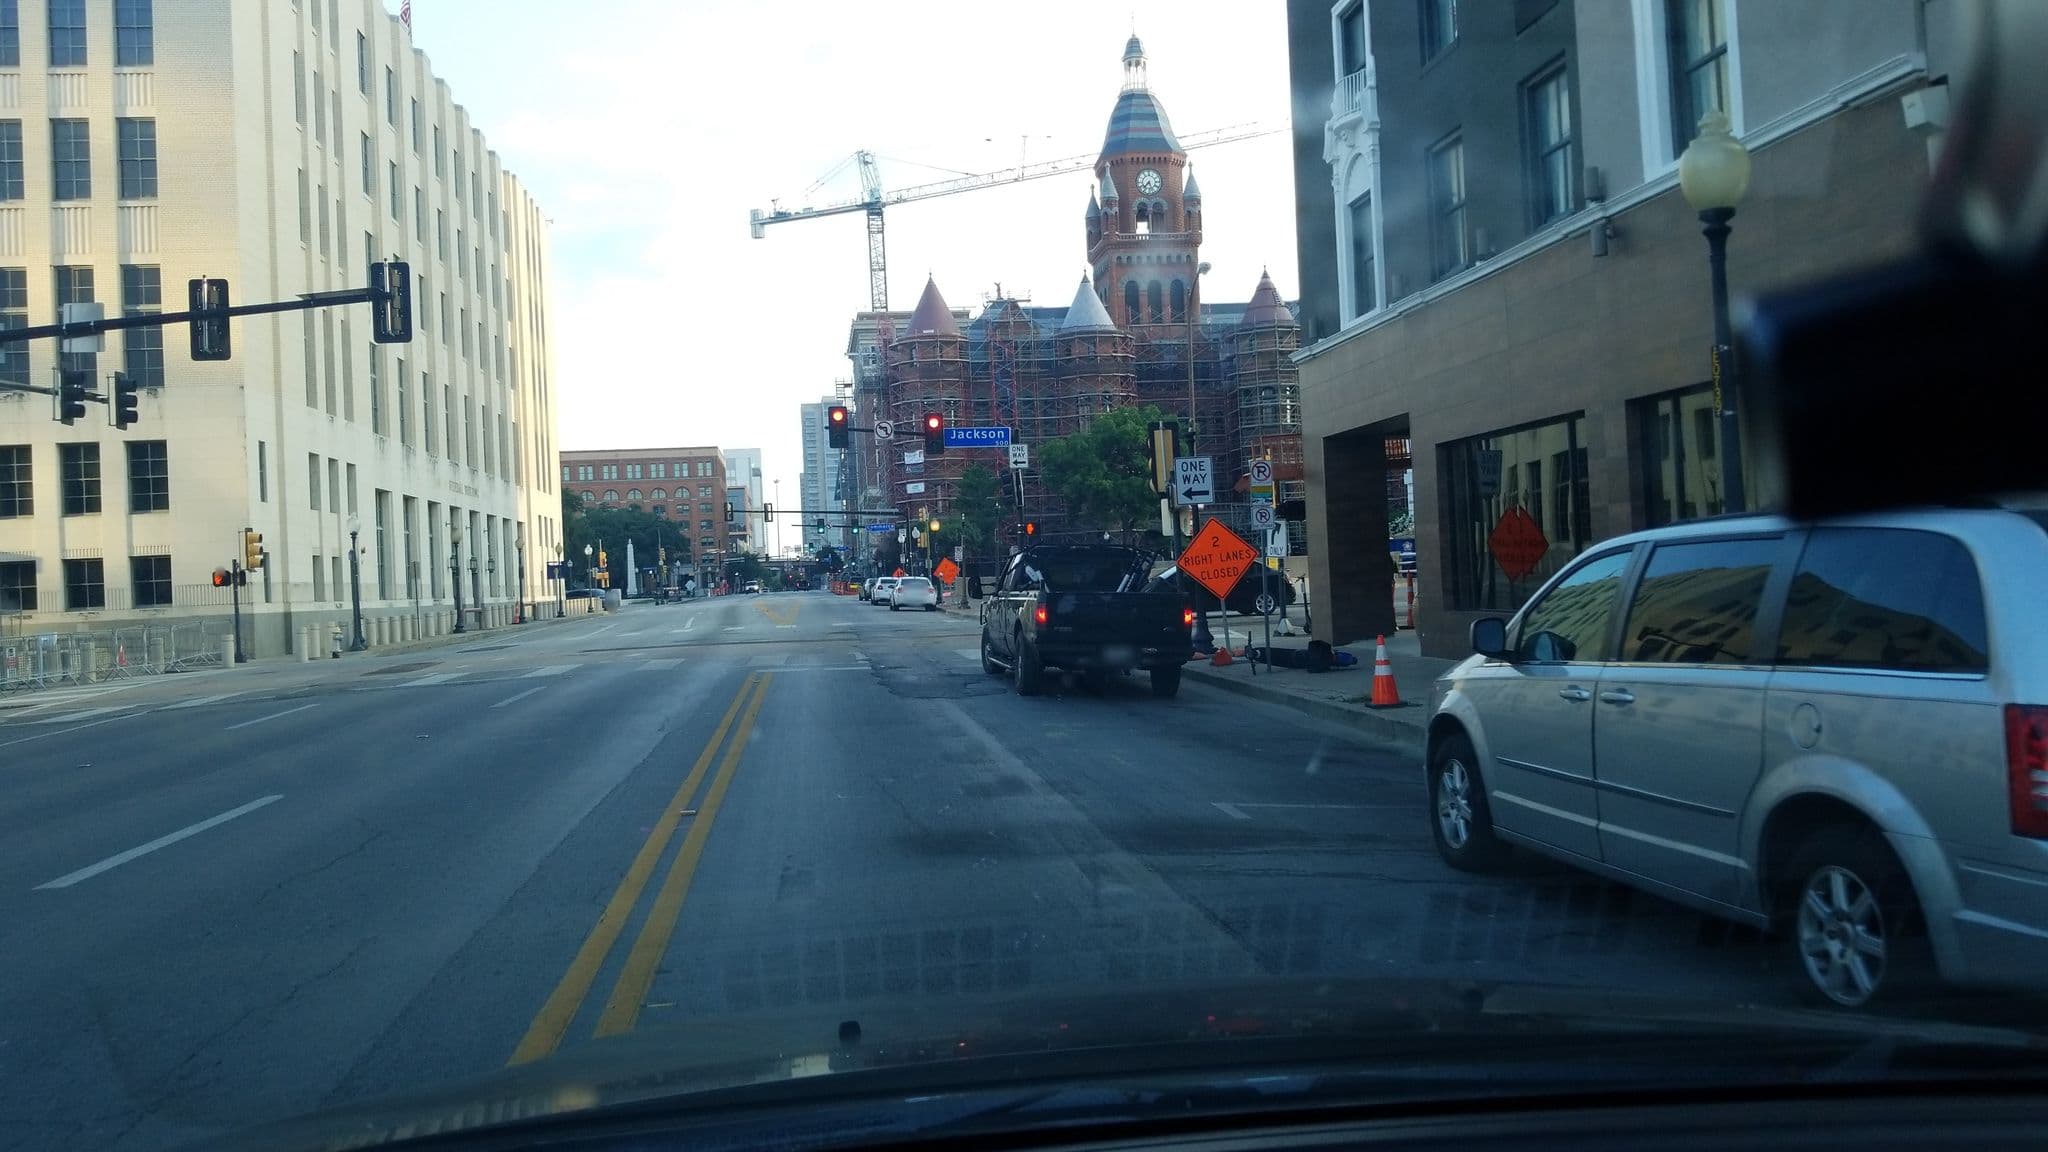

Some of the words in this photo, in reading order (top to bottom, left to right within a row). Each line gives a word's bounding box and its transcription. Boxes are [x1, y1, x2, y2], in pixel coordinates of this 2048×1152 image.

[950, 429, 1005, 440] Jackson
[1181, 460, 1206, 472] ONE
[1182, 473, 1208, 485] WAY
[1211, 536, 1220, 548] 2
[1269, 546, 1284, 555] ONLY
[1184, 553, 1213, 567] RIGHT
[1219, 549, 1252, 562] LANES
[1200, 566, 1240, 580] CLOSED
